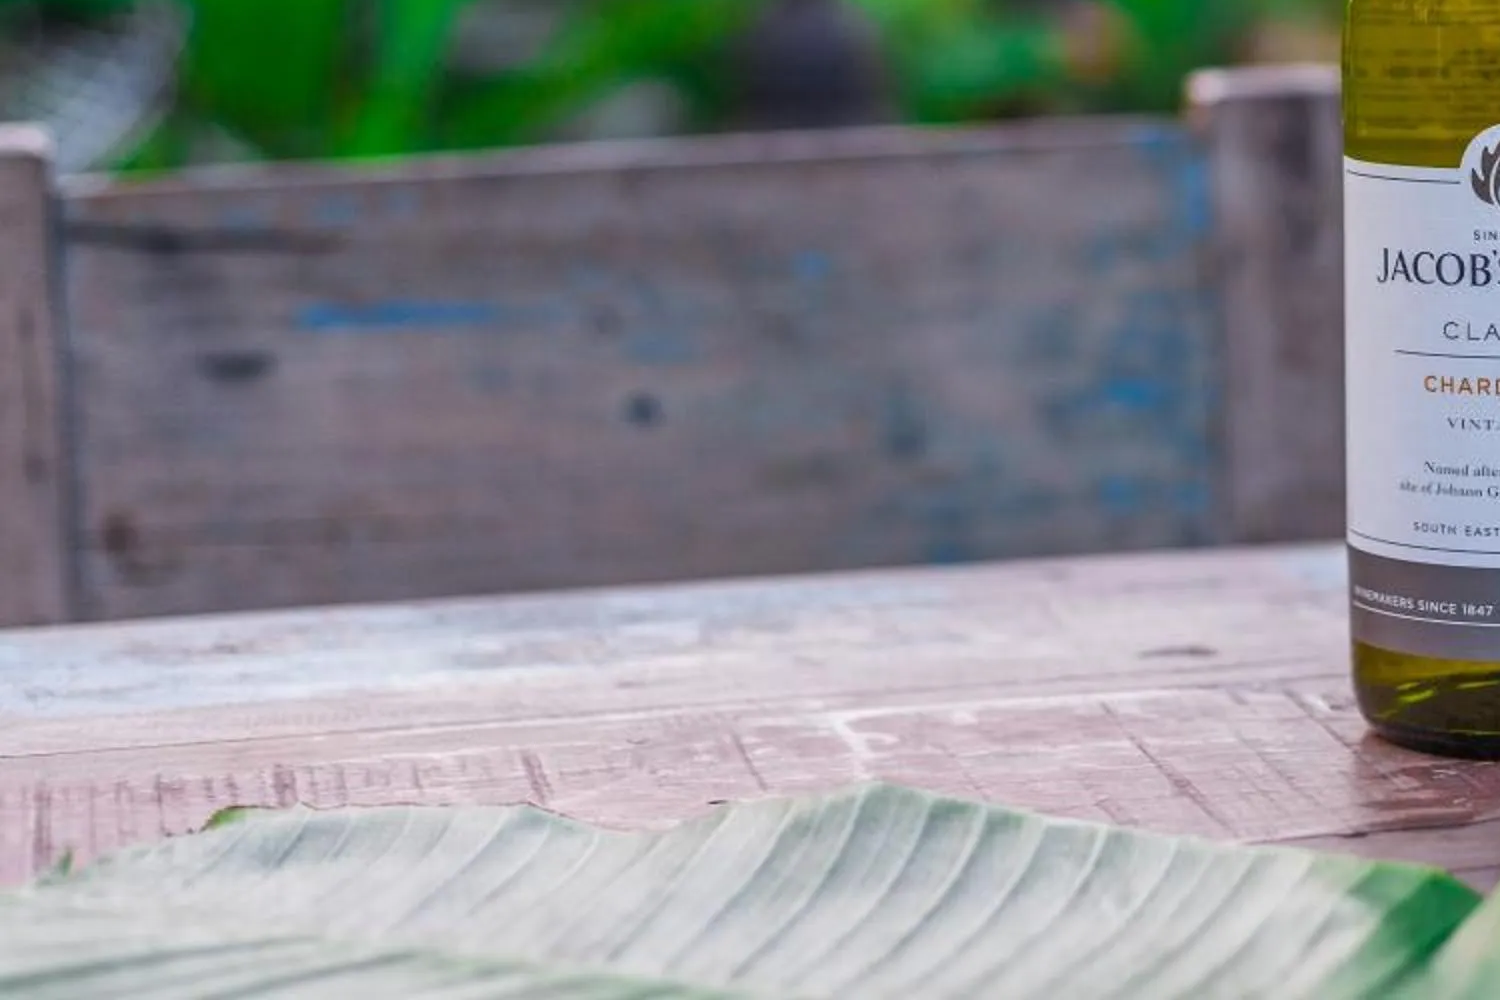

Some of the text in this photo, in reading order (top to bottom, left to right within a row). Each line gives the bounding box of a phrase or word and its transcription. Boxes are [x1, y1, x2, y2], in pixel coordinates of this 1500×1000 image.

[1424, 461, 1469, 477] Named
[1435, 483, 1483, 497] Johann
[1413, 521, 1457, 535] SOUTH
[1418, 599, 1457, 615] SINCE
[1462, 603, 1494, 617] 1847
